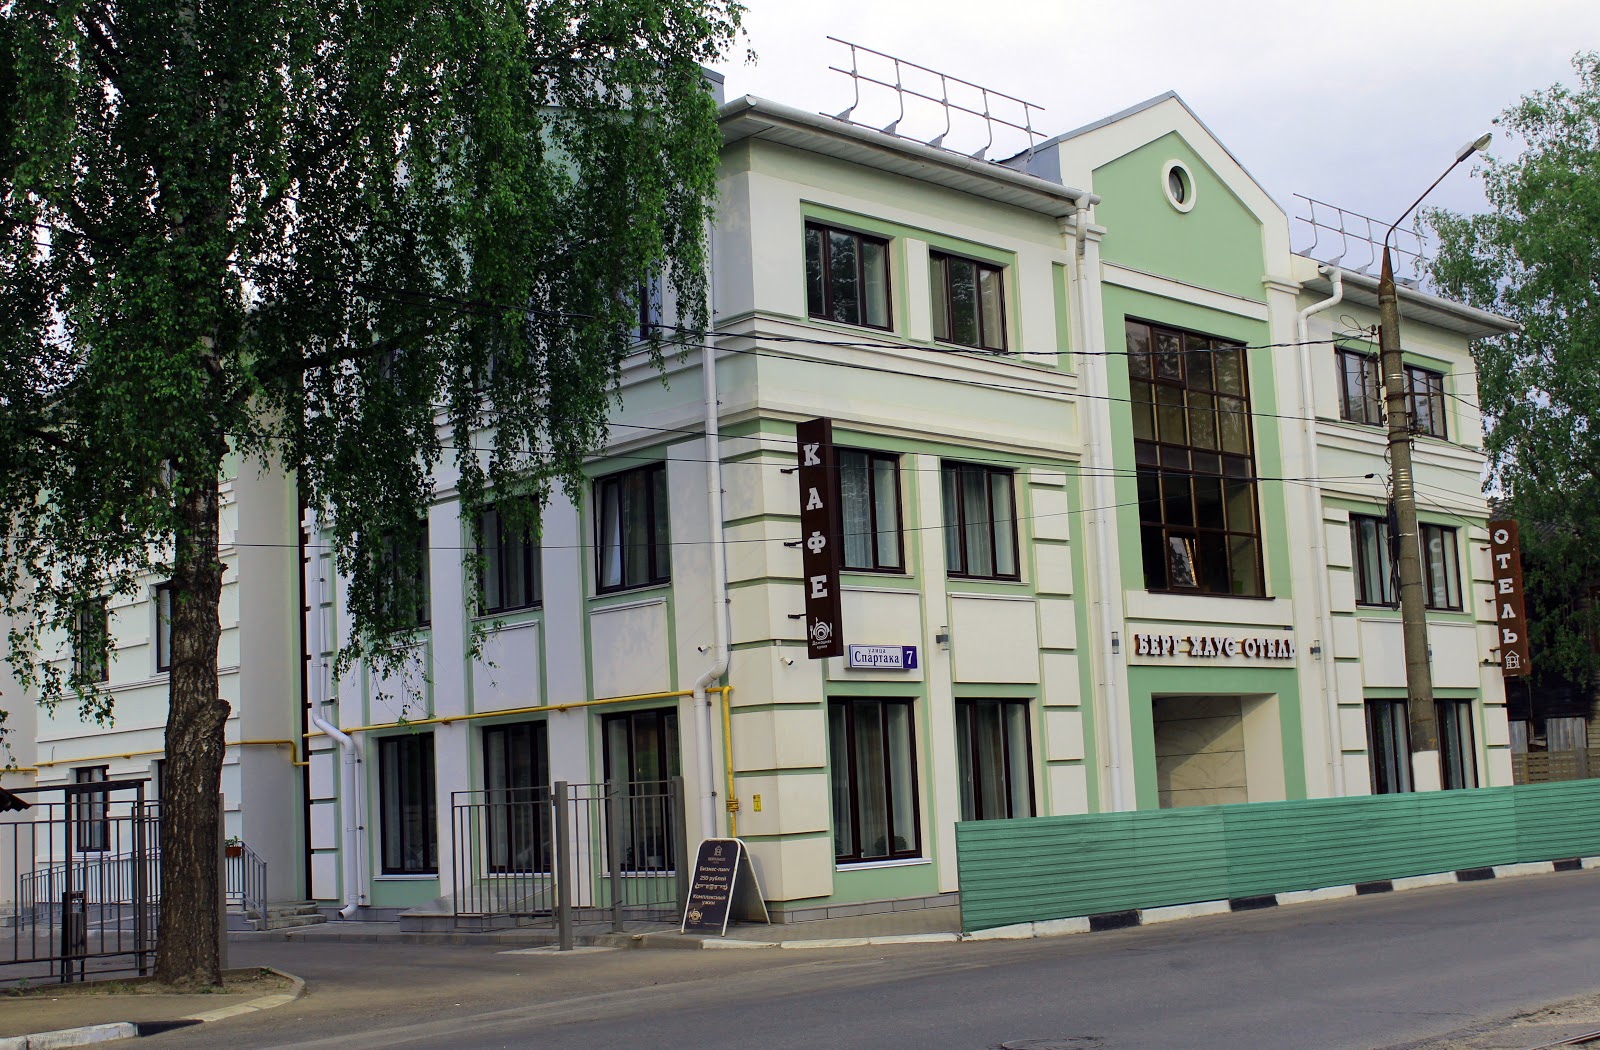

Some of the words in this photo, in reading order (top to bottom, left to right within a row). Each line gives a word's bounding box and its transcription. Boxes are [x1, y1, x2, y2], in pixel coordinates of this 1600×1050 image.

[803, 442, 828, 599] КАФЕ
[1494, 528, 1518, 644] ОТЕЛЬ
[854, 651, 900, 666] Спартака
[906, 651, 914, 665] 7
[1133, 634, 1181, 656] БЕРГ
[1187, 636, 1236, 657] ХАУС
[1241, 638, 1295, 659] ОТЕЛЬ
